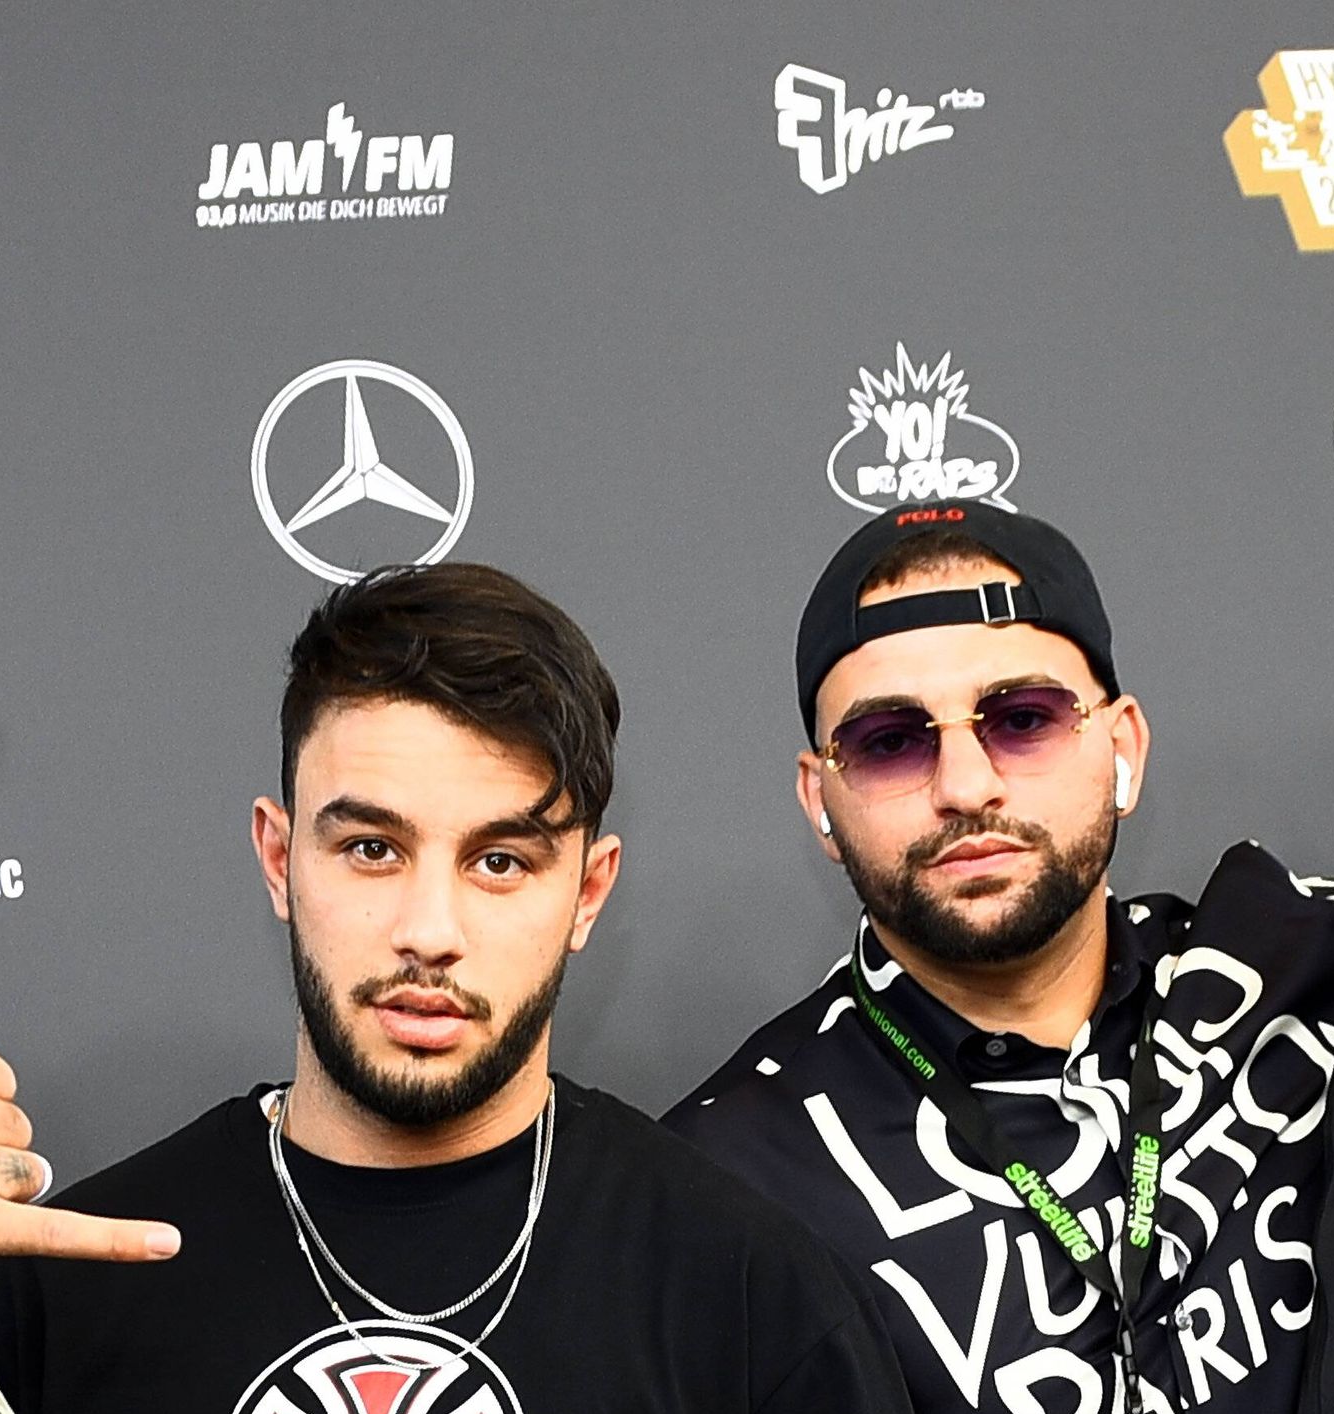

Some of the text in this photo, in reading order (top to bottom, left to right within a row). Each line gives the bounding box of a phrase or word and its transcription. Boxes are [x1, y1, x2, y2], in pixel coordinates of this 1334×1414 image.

[198, 134, 454, 200] JAM FM
[239, 202, 296, 225] MUSIK
[298, 200, 327, 222] DIE
[376, 194, 449, 217] BEWEGT
[874, 396, 949, 463] YO!
